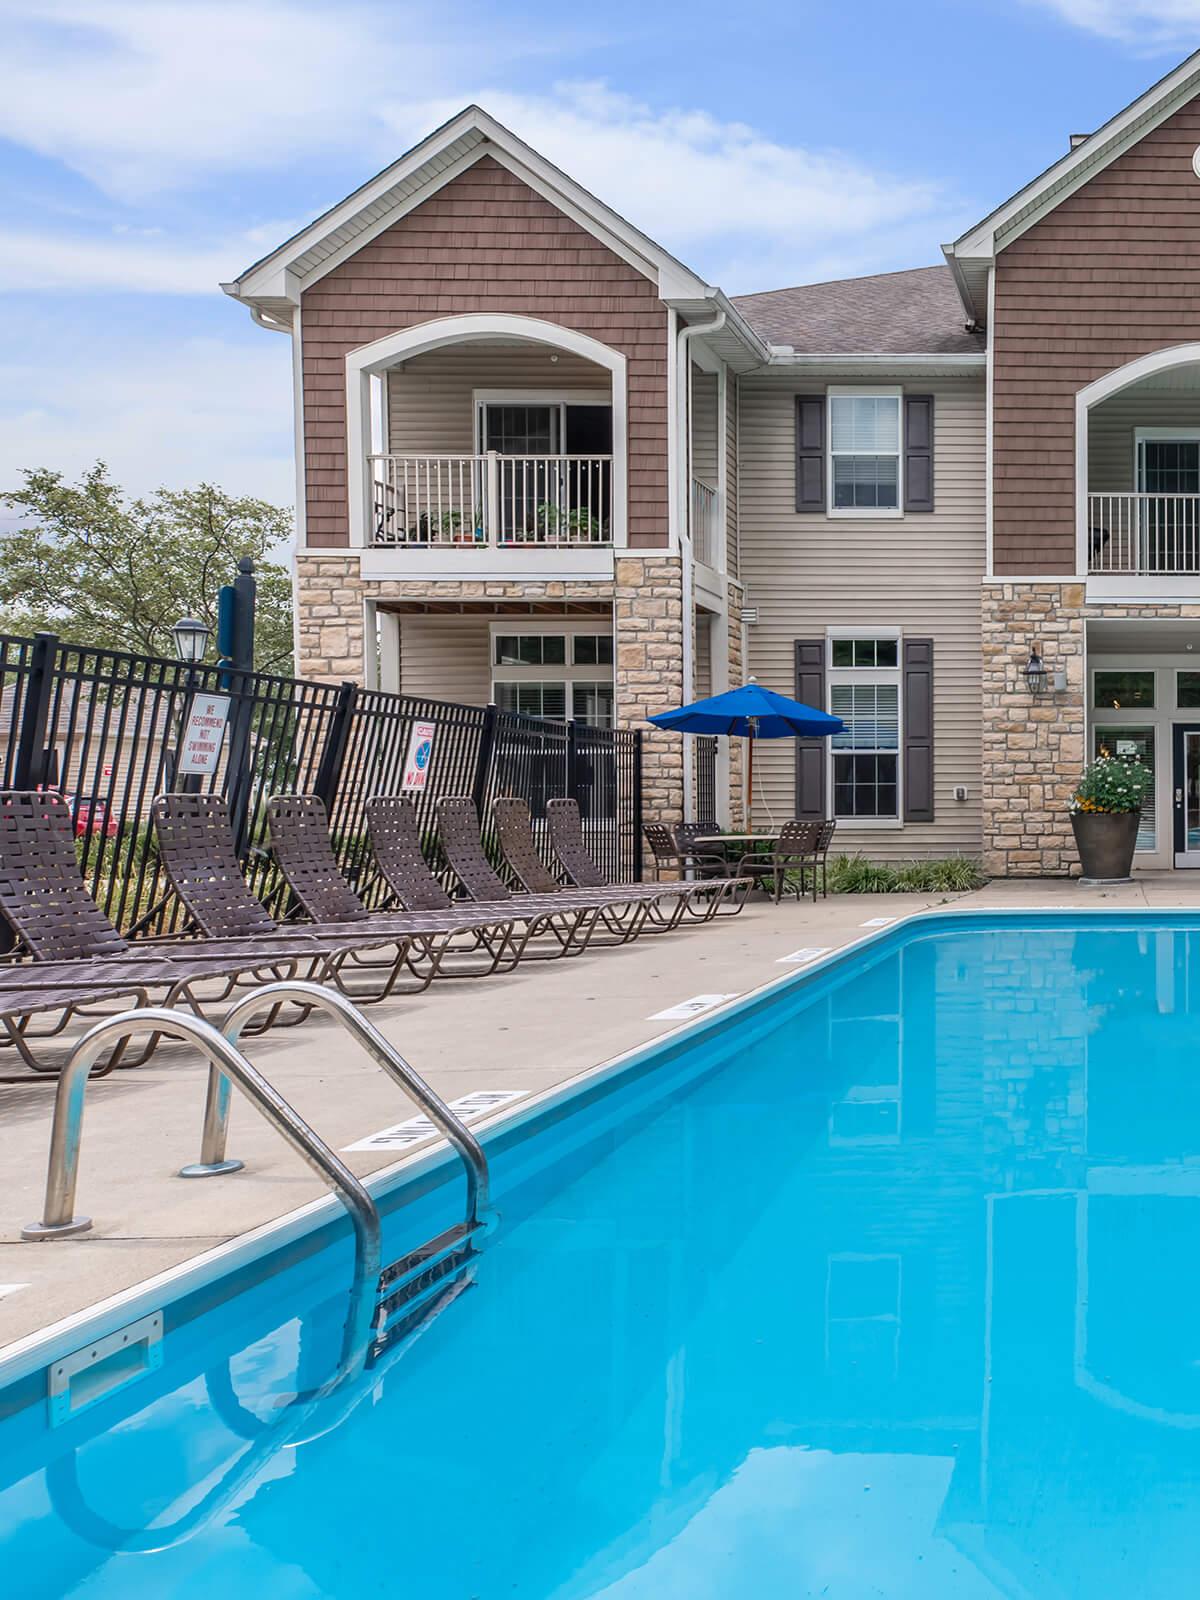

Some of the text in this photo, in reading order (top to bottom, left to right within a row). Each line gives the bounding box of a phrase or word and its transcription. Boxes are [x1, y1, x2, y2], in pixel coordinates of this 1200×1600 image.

[206, 704, 215, 715] WE
[192, 715, 223, 729] RECOMMEND
[199, 729, 210, 740] NOT
[188, 740, 216, 753] SWIMMING
[191, 753, 208, 765] ALONE
[459, 1093, 513, 1105] NO
